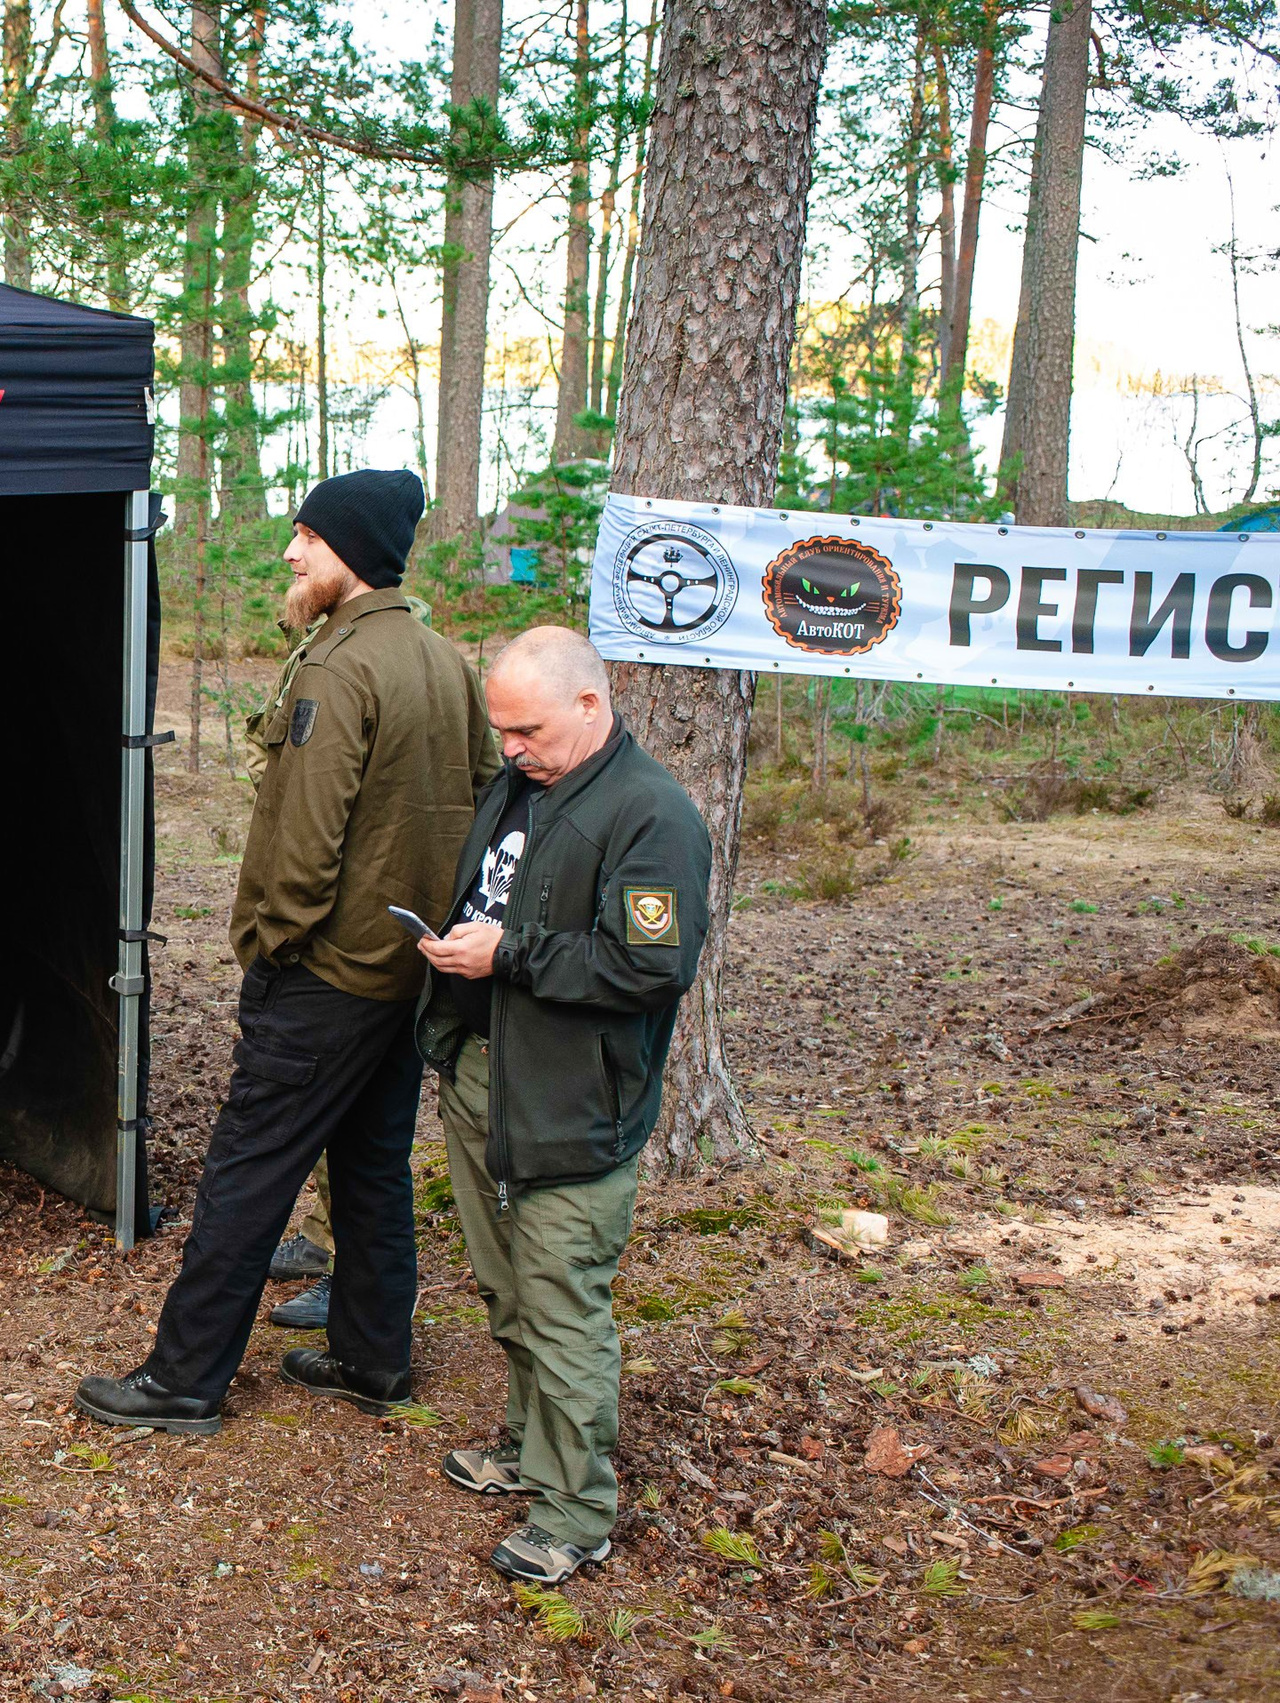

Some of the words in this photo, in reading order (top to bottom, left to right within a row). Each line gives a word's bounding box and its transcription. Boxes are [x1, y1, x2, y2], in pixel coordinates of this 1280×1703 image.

[637, 523, 715, 548] САНКТ-ПЕТЕРБУРГА
[798, 546, 821, 561] КЛУБ
[715, 554, 737, 623] ЛЕНИНГРАДСКОЙ
[949, 562, 1280, 663] РЕГИС
[678, 621, 717, 641] ОБЛАСТИ
